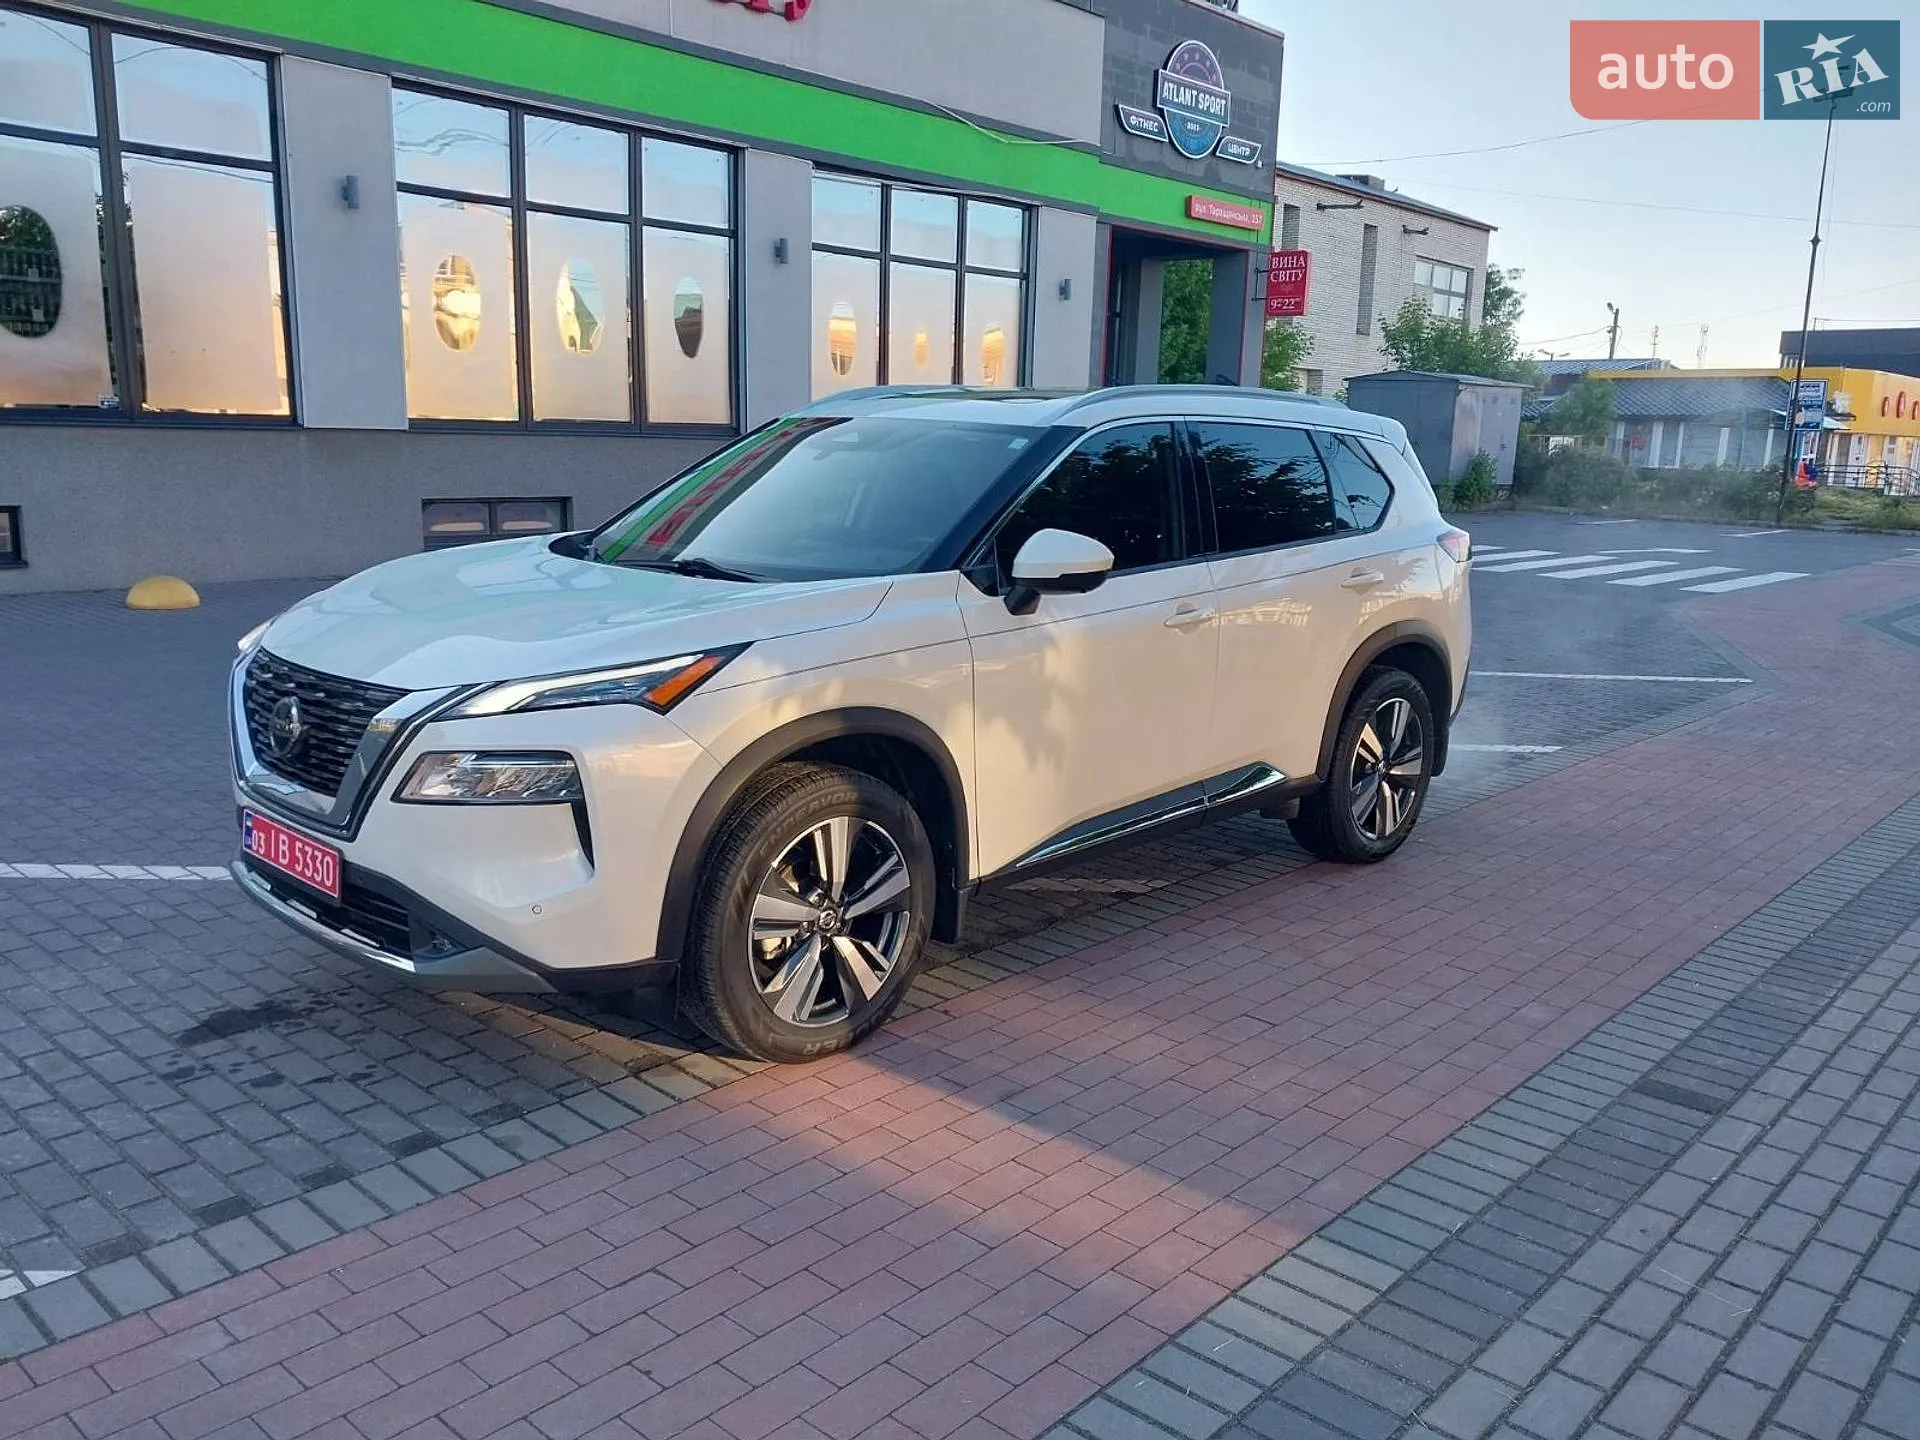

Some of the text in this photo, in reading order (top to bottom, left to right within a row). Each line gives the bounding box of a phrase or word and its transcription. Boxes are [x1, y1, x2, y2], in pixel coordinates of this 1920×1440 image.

[1162, 81, 1226, 117] ATLANT SPORT
[1228, 142, 1251, 156] ЦЕНТР
[1272, 255, 1306, 268] ВИНА
[1270, 269, 1306, 282] СВІТУ
[252, 829, 266, 855] 03
[295, 840, 333, 887] 5330
